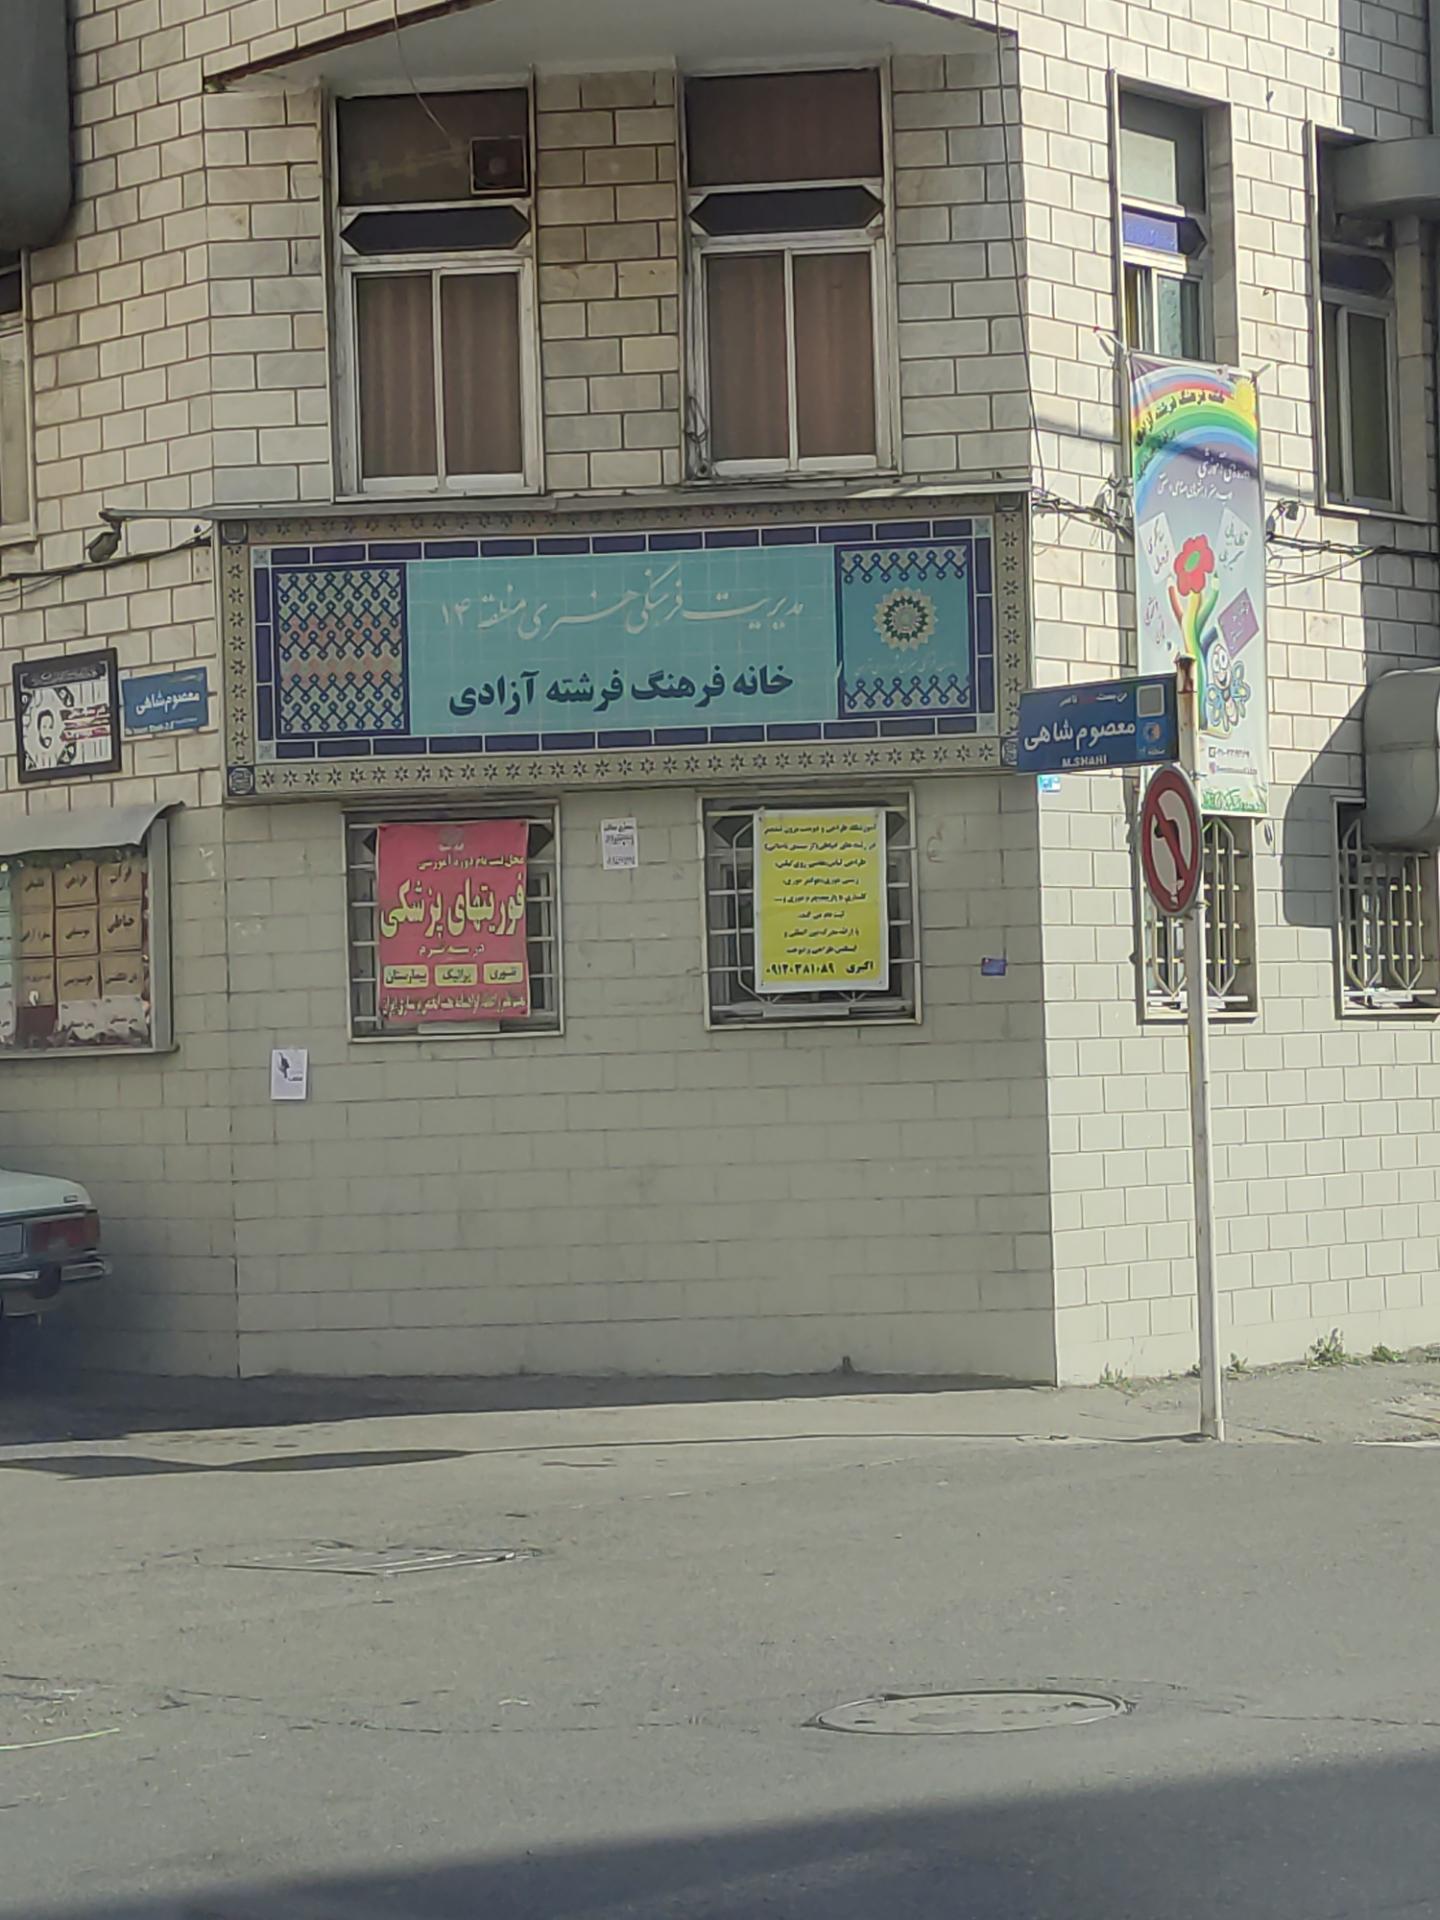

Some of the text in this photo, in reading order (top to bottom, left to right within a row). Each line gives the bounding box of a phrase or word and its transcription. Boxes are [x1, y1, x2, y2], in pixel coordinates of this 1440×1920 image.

[440, 597, 471, 626] ۱۴
[477, 584, 528, 631] منطقه
[682, 589, 805, 633] مدیریت
[448, 663, 794, 717] خانه فرهنگ فرشته آزادی
[1023, 719, 1136, 751] معصوم شاهی
[380, 872, 526, 940] فوریتهای پزشکی
